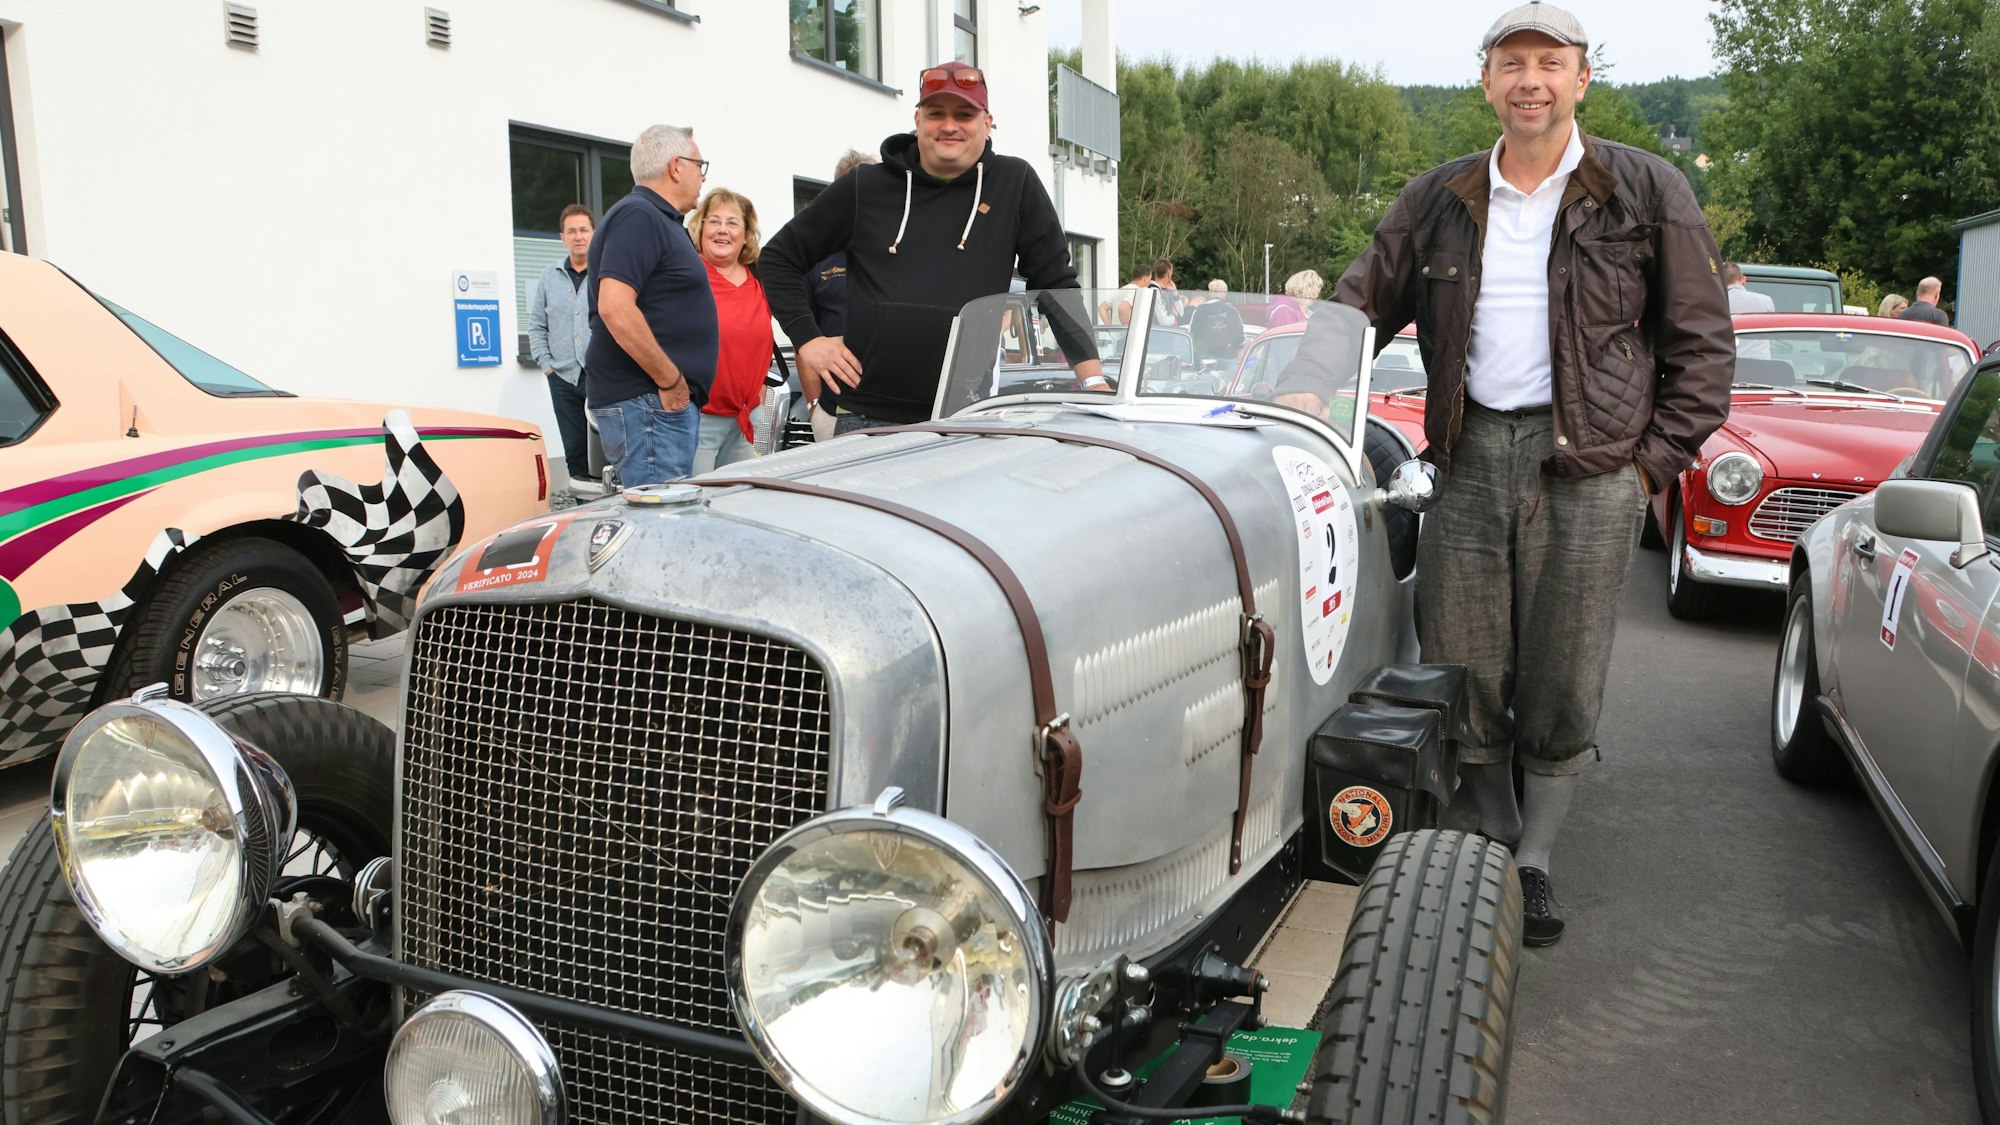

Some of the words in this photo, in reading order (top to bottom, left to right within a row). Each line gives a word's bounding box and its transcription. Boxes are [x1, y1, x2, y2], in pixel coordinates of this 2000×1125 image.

[471, 322, 482, 345] P
[1325, 523, 1337, 585] 2
[516, 568, 539, 581] 2024
[1887, 575, 1902, 622] 1
[174, 573, 248, 696] GENERAL
[1366, 812, 1389, 843] MIXTURE
